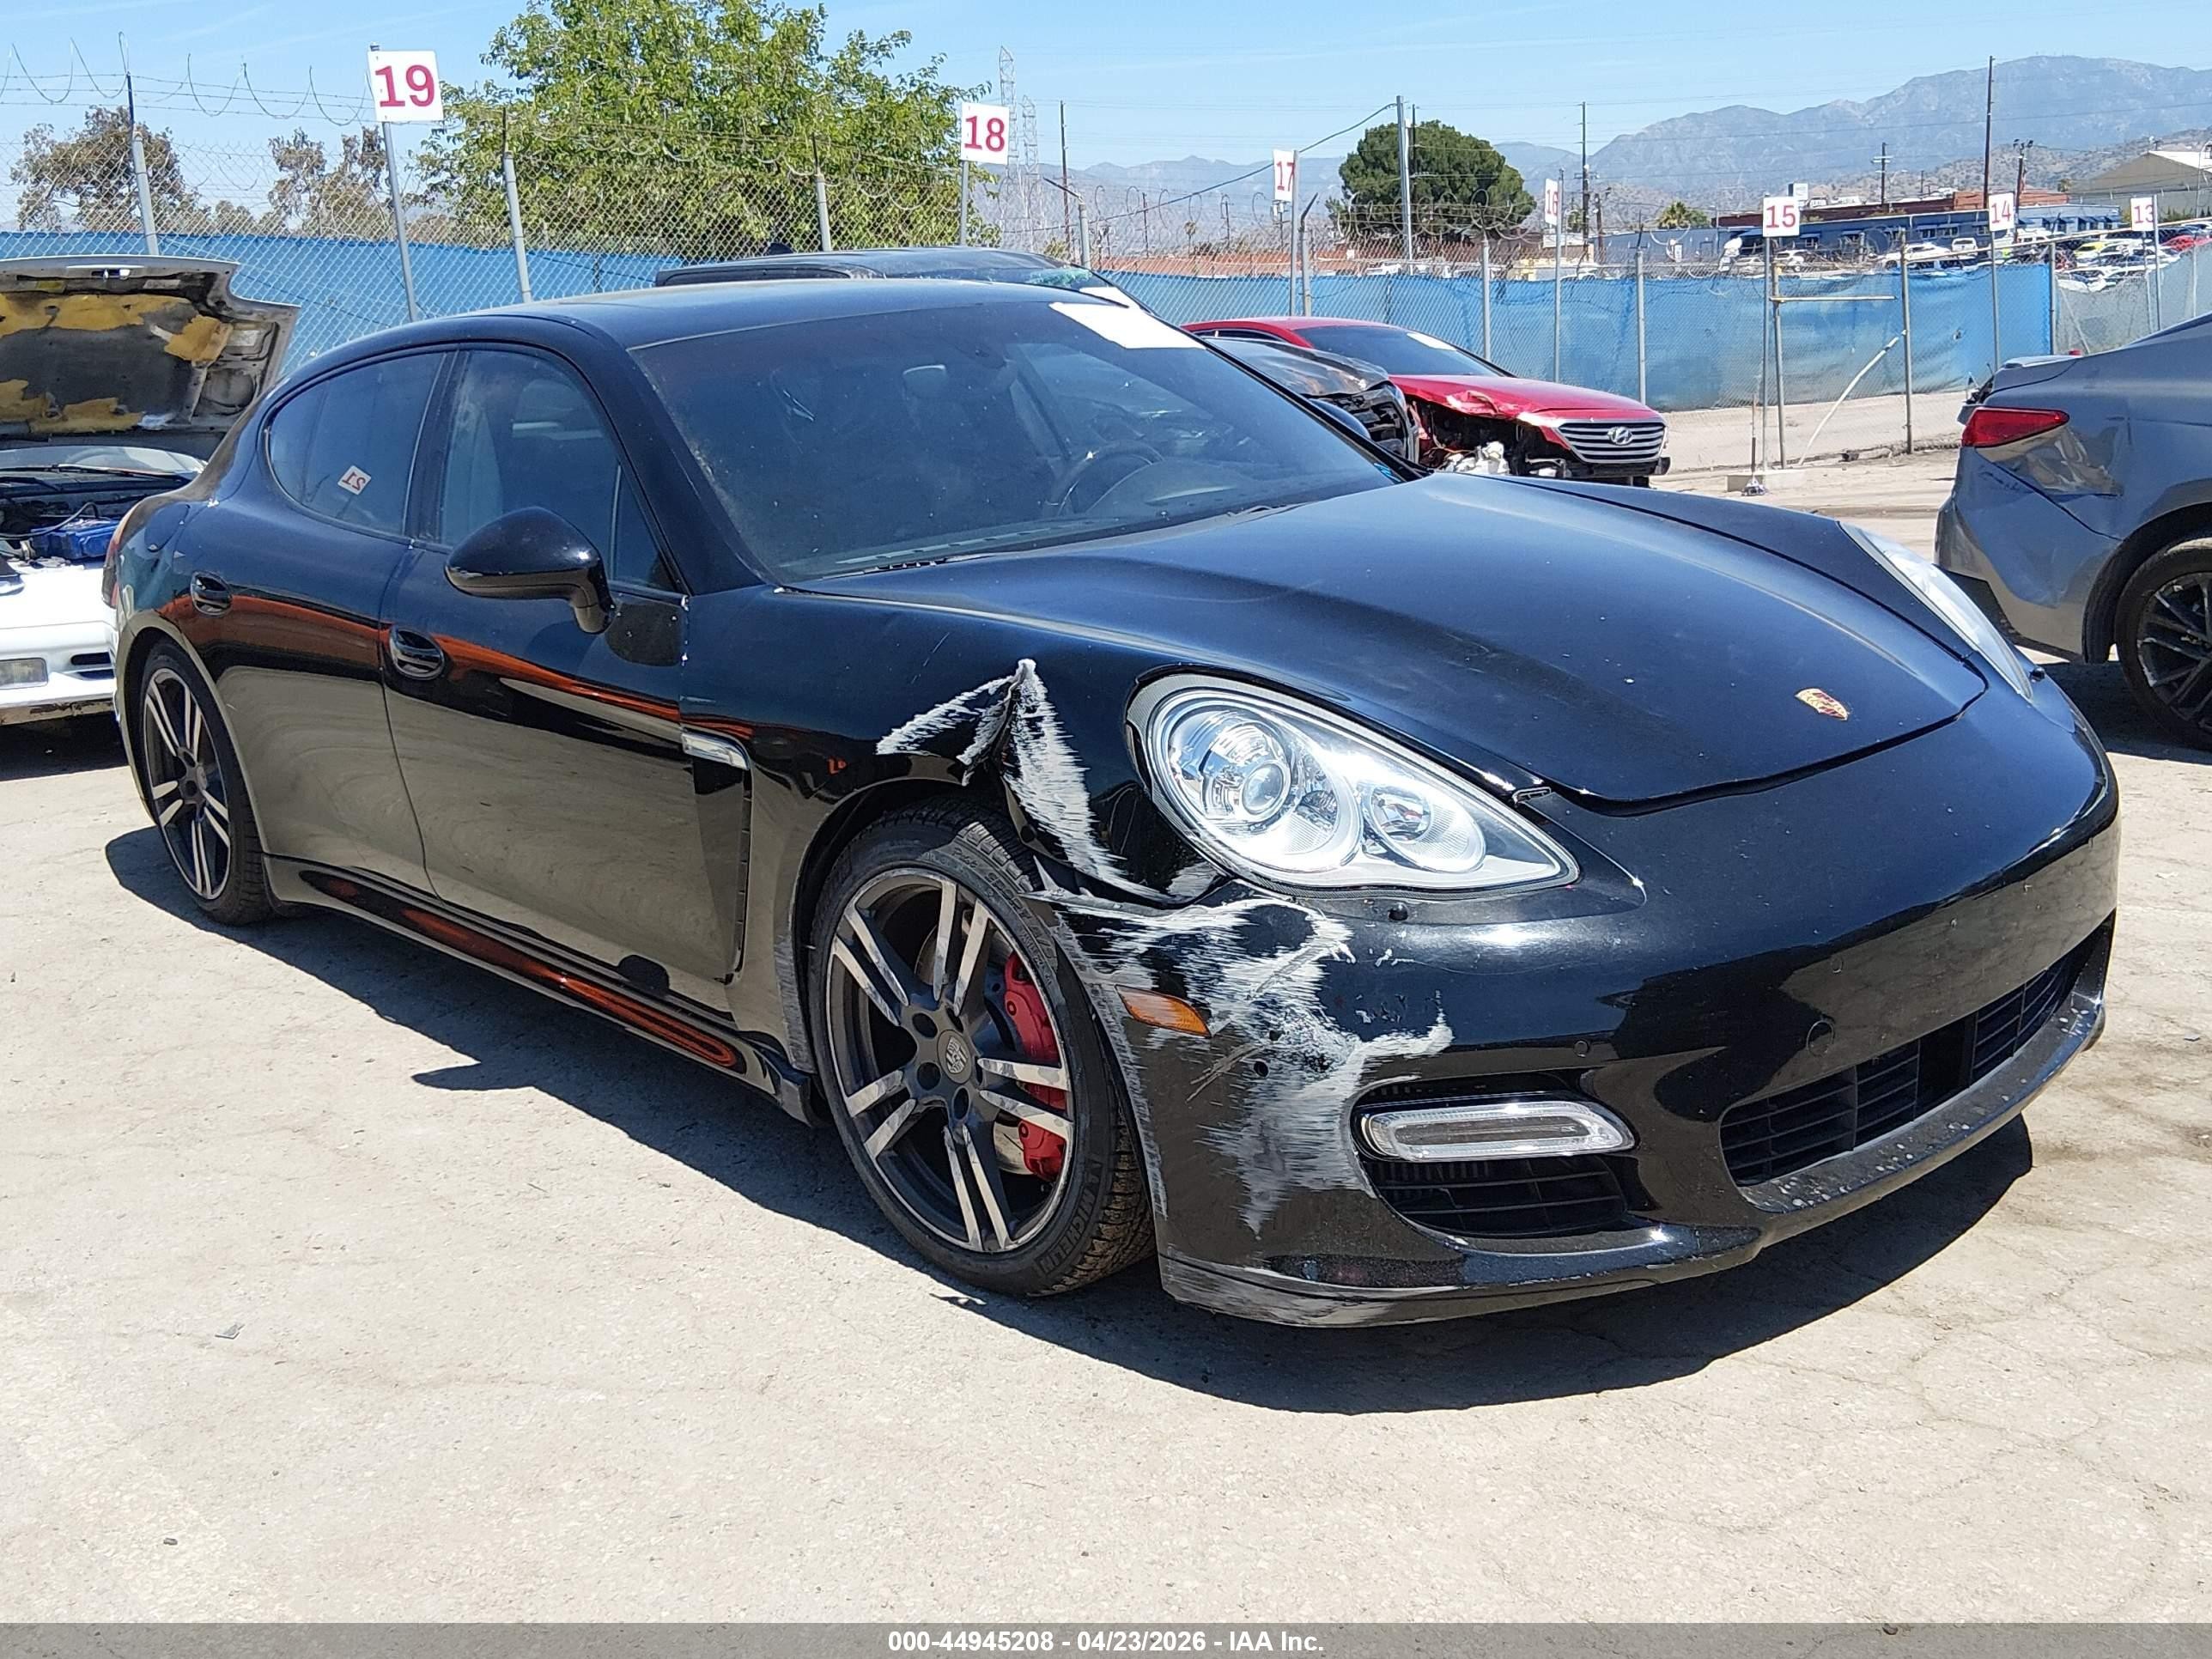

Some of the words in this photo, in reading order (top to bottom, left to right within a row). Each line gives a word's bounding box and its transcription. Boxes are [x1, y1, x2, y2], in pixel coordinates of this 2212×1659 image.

[375, 64, 434, 107] 19
[964, 115, 1005, 152] 18
[1277, 161, 1295, 191] 17
[1765, 204, 1796, 228] 15
[1991, 200, 2011, 223] 14
[2134, 204, 2154, 223] 13
[985, 872, 1032, 921] SPORT
[1036, 1188, 1097, 1274] MICHELIN
